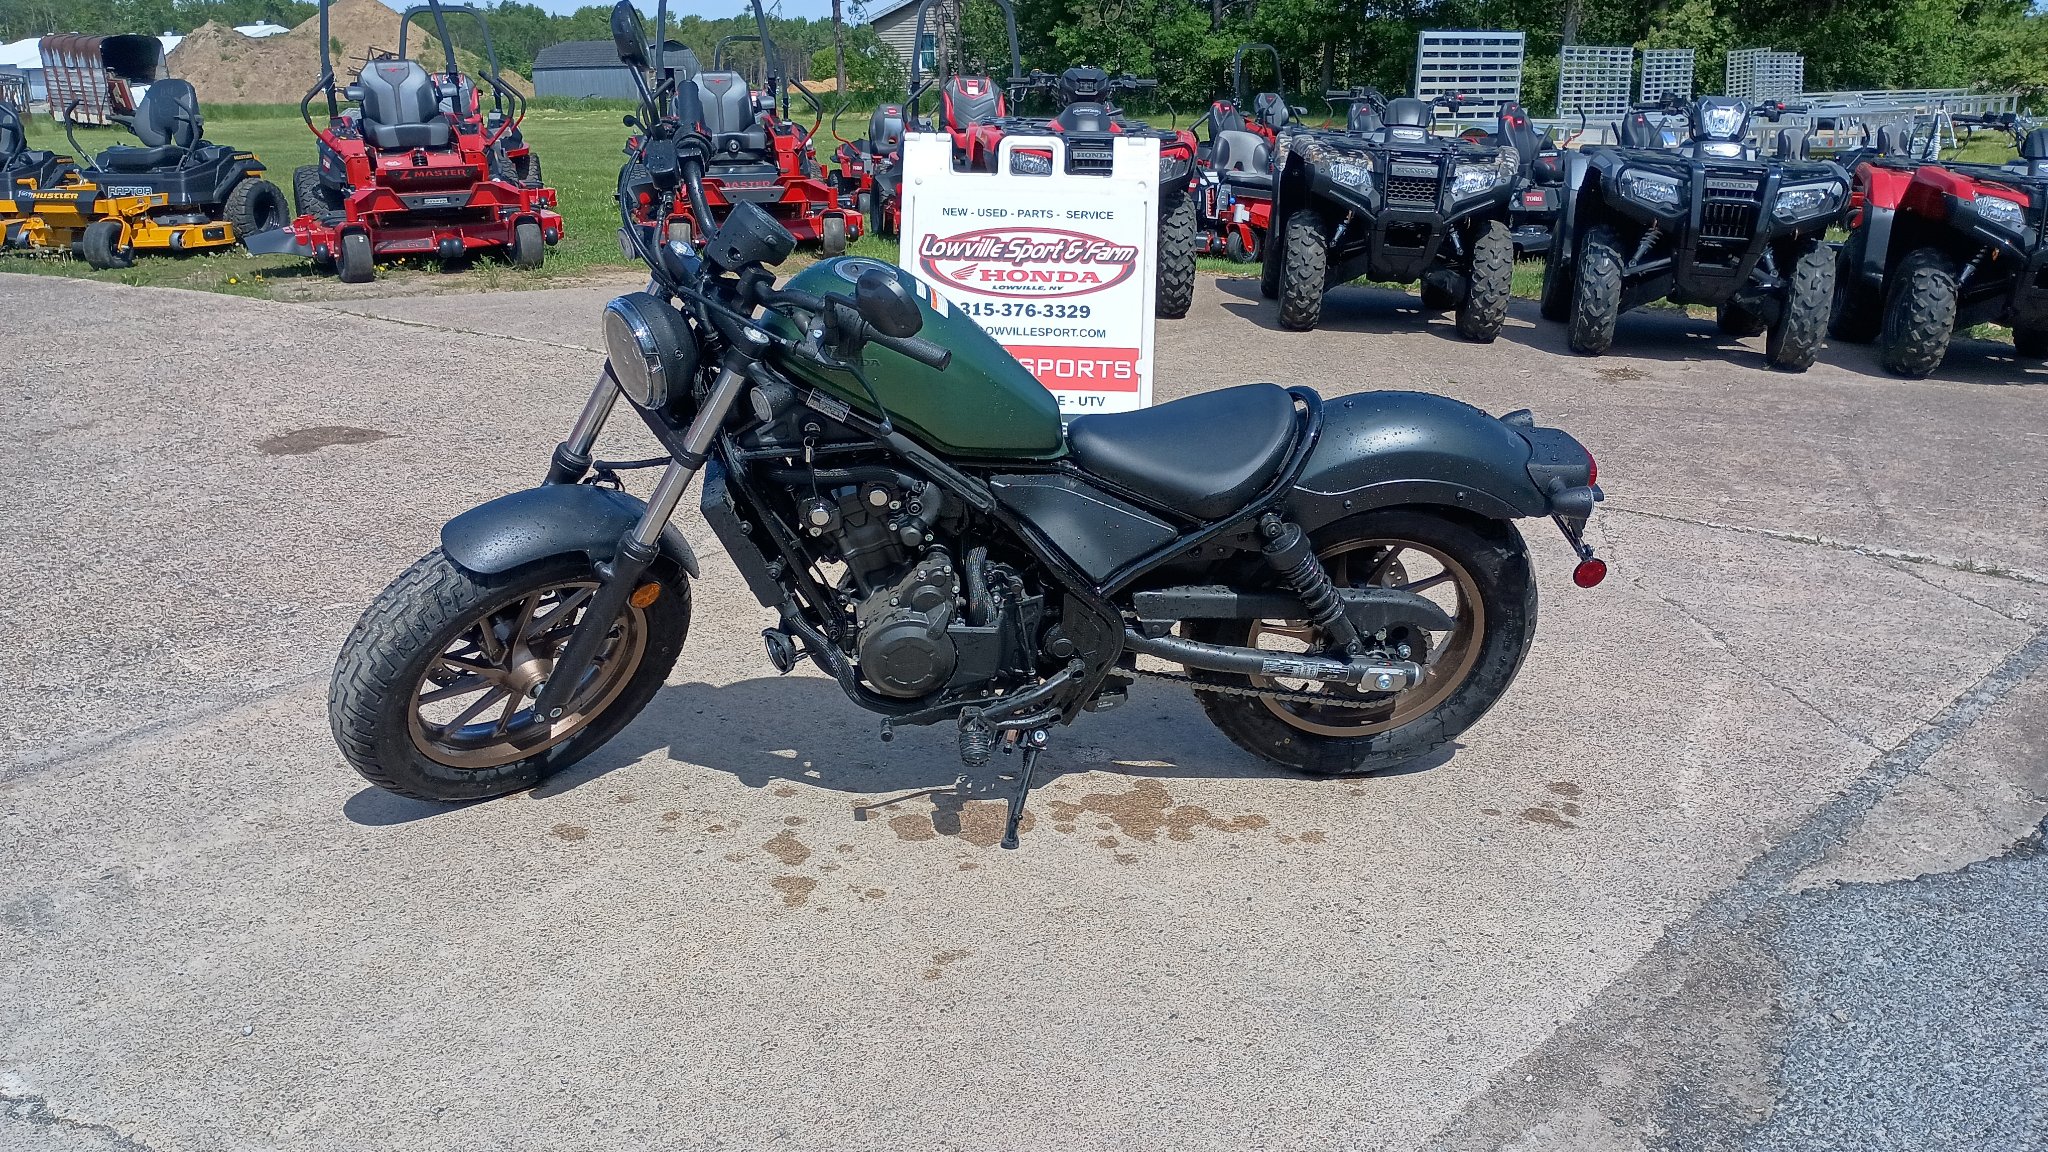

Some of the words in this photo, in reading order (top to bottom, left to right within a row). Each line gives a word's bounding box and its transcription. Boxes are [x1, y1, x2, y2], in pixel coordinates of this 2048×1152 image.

[414, 169, 467, 178] MASTER
[107, 185, 153, 198] RAPTOR
[1711, 181, 1755, 190] HONDA
[942, 207, 968, 217] NEW
[978, 208, 1007, 218] USED
[1018, 209, 1053, 219] PARTS
[1066, 210, 1114, 220] SERVICE
[920, 235, 1001, 258] Lowville
[1003, 238, 1063, 264] Sport
[1065, 239, 1084, 259] &
[1085, 240, 1136, 262] Farm
[979, 269, 1103, 284] HONDA
[960, 302, 1091, 319] 315-376-3329
[1078, 396, 1106, 407] UTV
